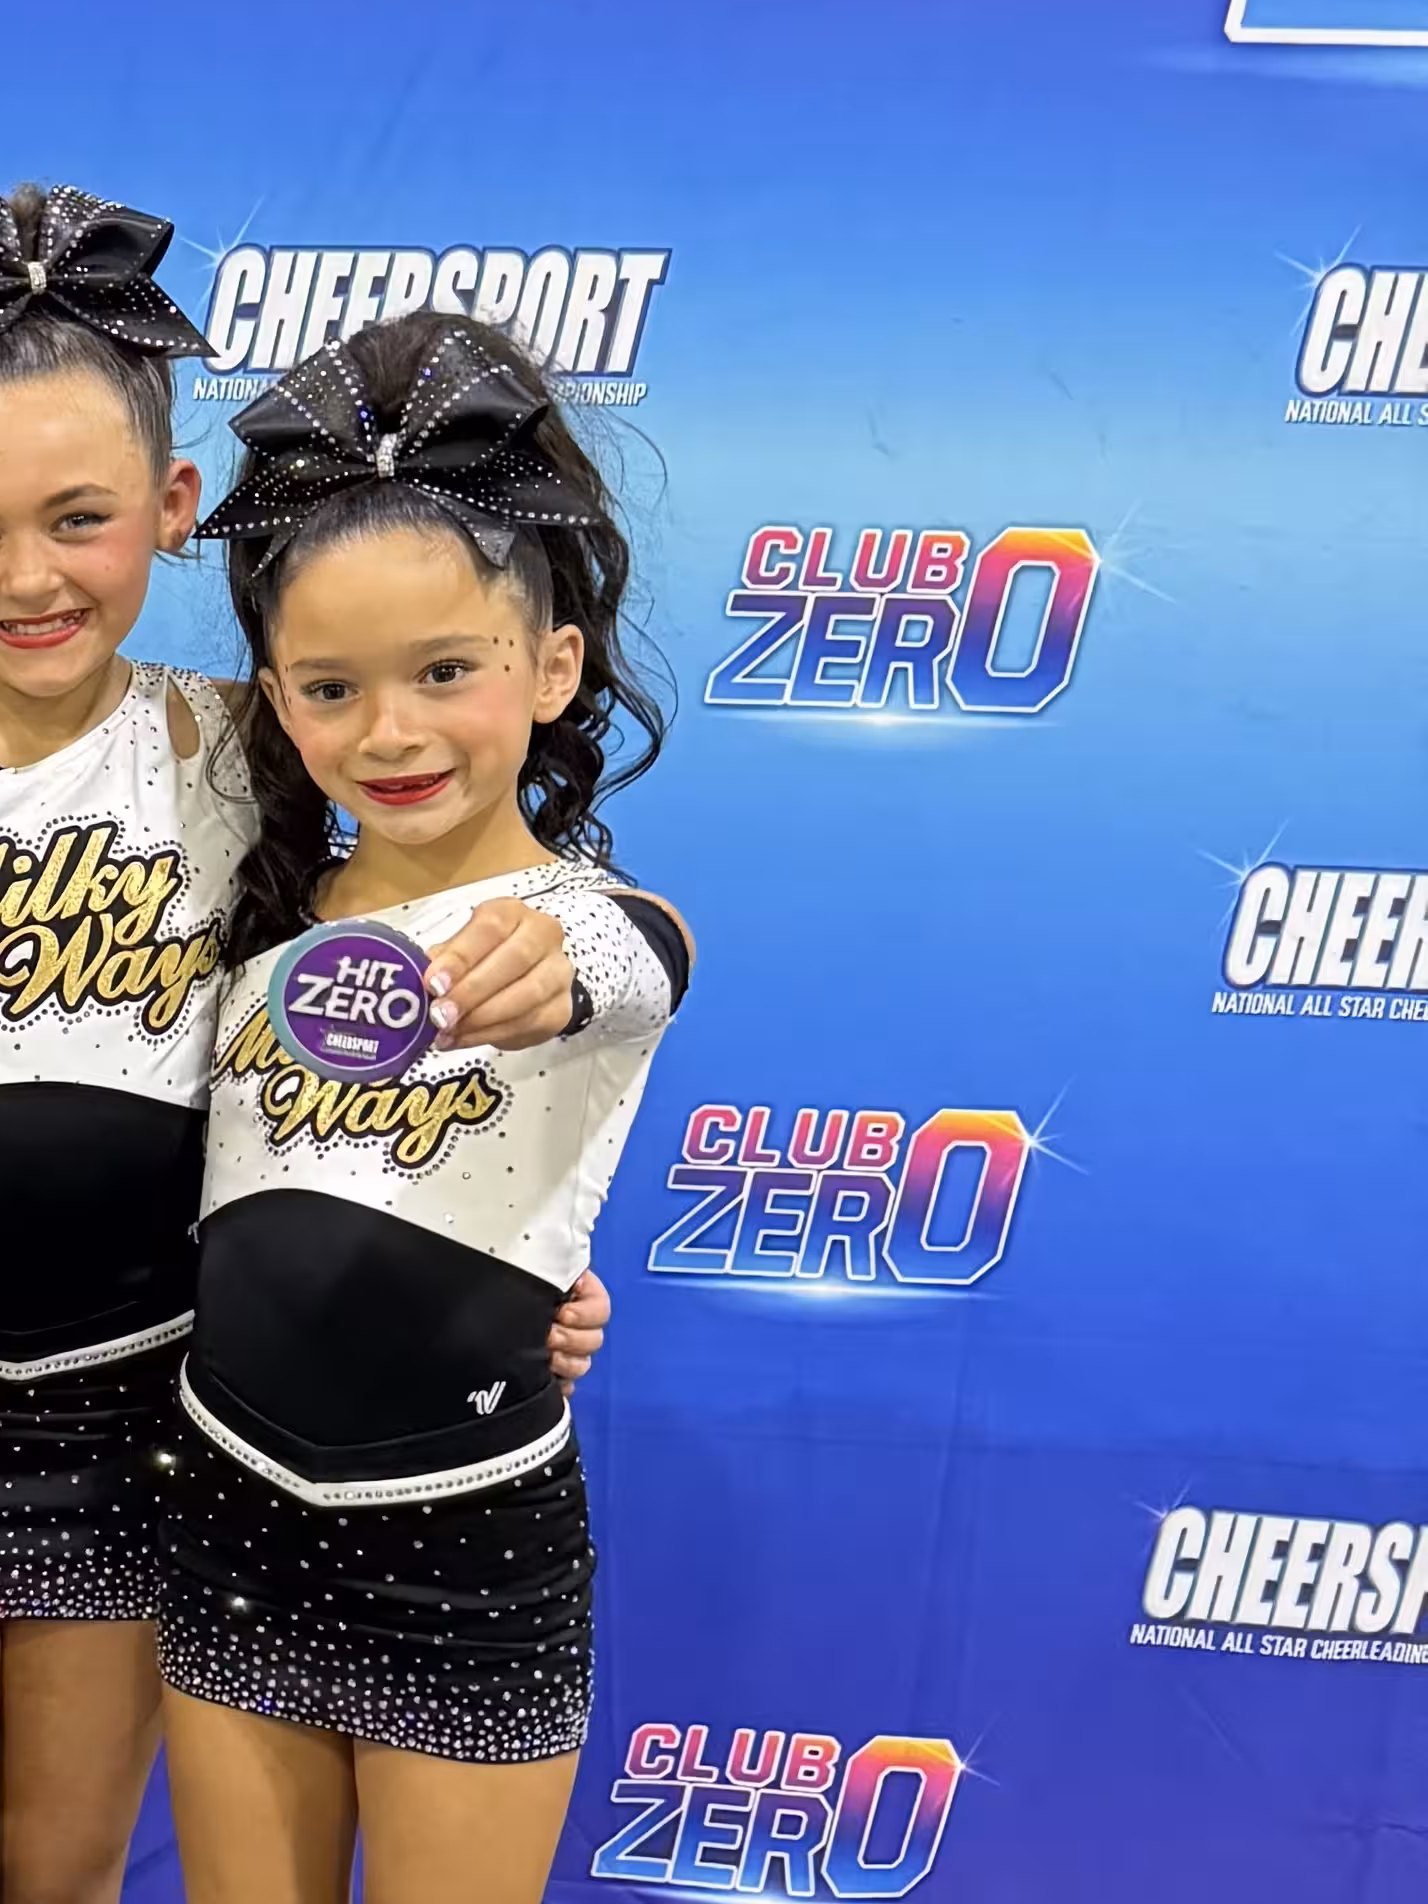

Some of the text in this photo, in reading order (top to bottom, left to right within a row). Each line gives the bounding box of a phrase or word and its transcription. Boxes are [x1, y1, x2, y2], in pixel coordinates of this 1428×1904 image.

[1284, 399, 1373, 425] NATIONAL
[1378, 401, 1413, 427] ALL
[741, 525, 971, 594] CLUB
[703, 526, 1102, 713] ZERO
[288, 973, 421, 1029] ZERO
[337, 956, 404, 991] HIT
[1212, 991, 1295, 1016] NATIONAL
[1300, 994, 1333, 1018] ALL
[1338, 995, 1386, 1020] STAR
[262, 1064, 498, 1165] Ways
[681, 1103, 906, 1172] CLUB
[646, 1107, 1032, 1286] ZERO
[1130, 1623, 1216, 1651] NATIONAL
[1221, 1631, 1254, 1655] ALL
[1259, 1633, 1306, 1658] STAR
[624, 1722, 842, 1793] CLUB
[590, 1734, 964, 1898] ZERO
